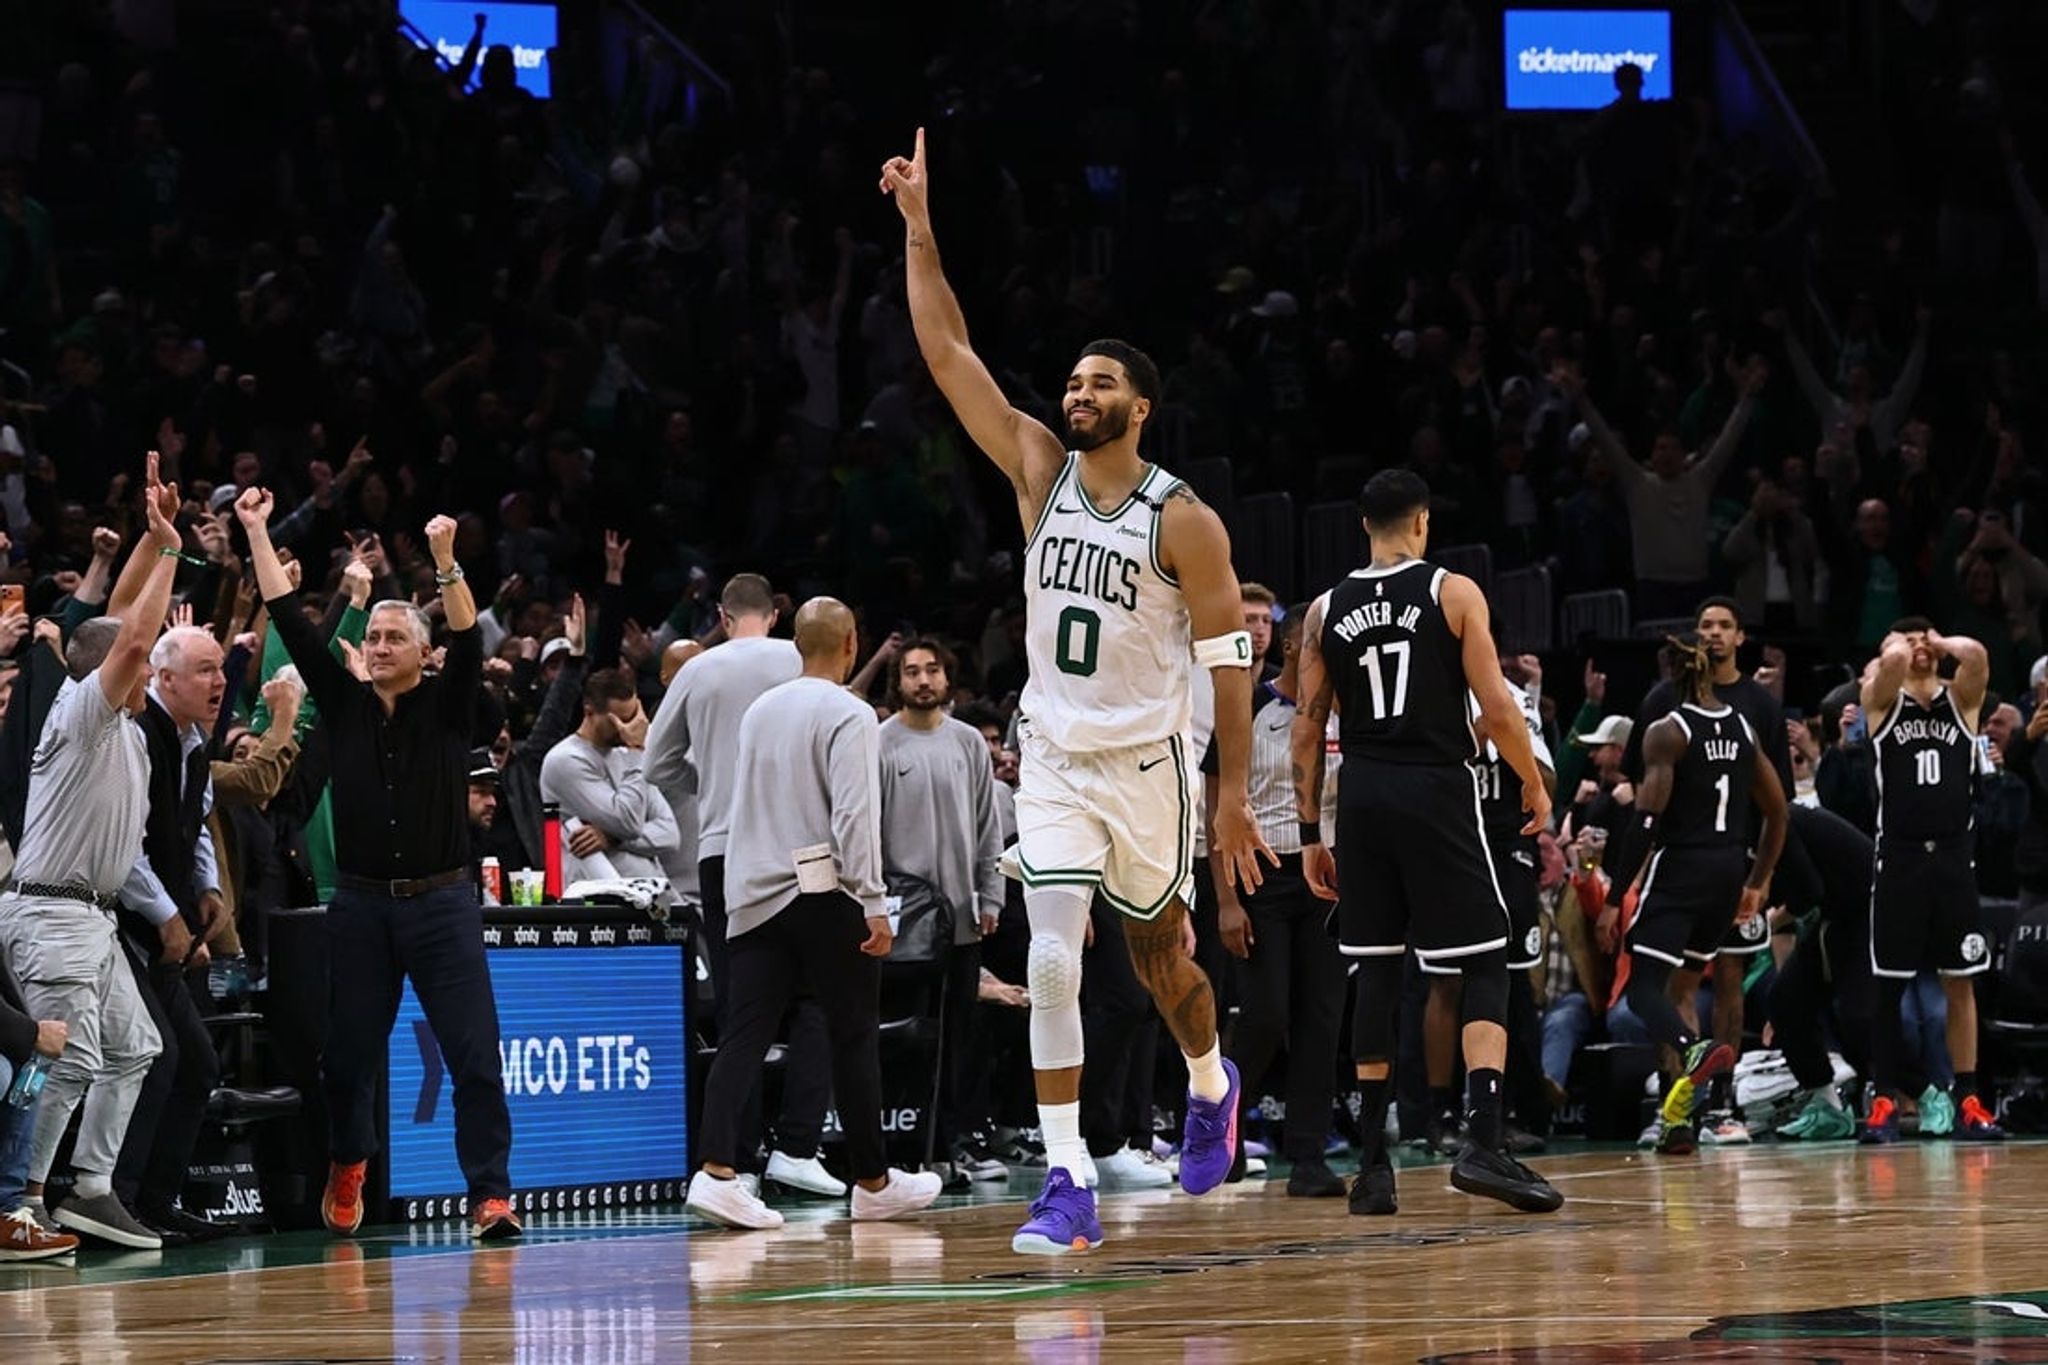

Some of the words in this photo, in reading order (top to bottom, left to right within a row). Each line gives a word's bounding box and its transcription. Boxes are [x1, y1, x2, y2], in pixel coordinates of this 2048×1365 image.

[1039, 536, 1141, 612] CELTICS
[1056, 605, 1102, 677] 0
[1333, 601, 1392, 643] PORTER
[1396, 604, 1422, 633] JR.
[1358, 640, 1411, 720] 17
[1704, 739, 1739, 761] ELLIS
[1915, 748, 1941, 786] 10
[1475, 764, 1500, 799] 31
[1715, 774, 1730, 832] 1
[514, 926, 540, 945] xfinity
[552, 925, 578, 945] xfinity
[590, 925, 615, 945] xfinity
[499, 1036, 567, 1095] MCO
[577, 1035, 650, 1090] ETFs
